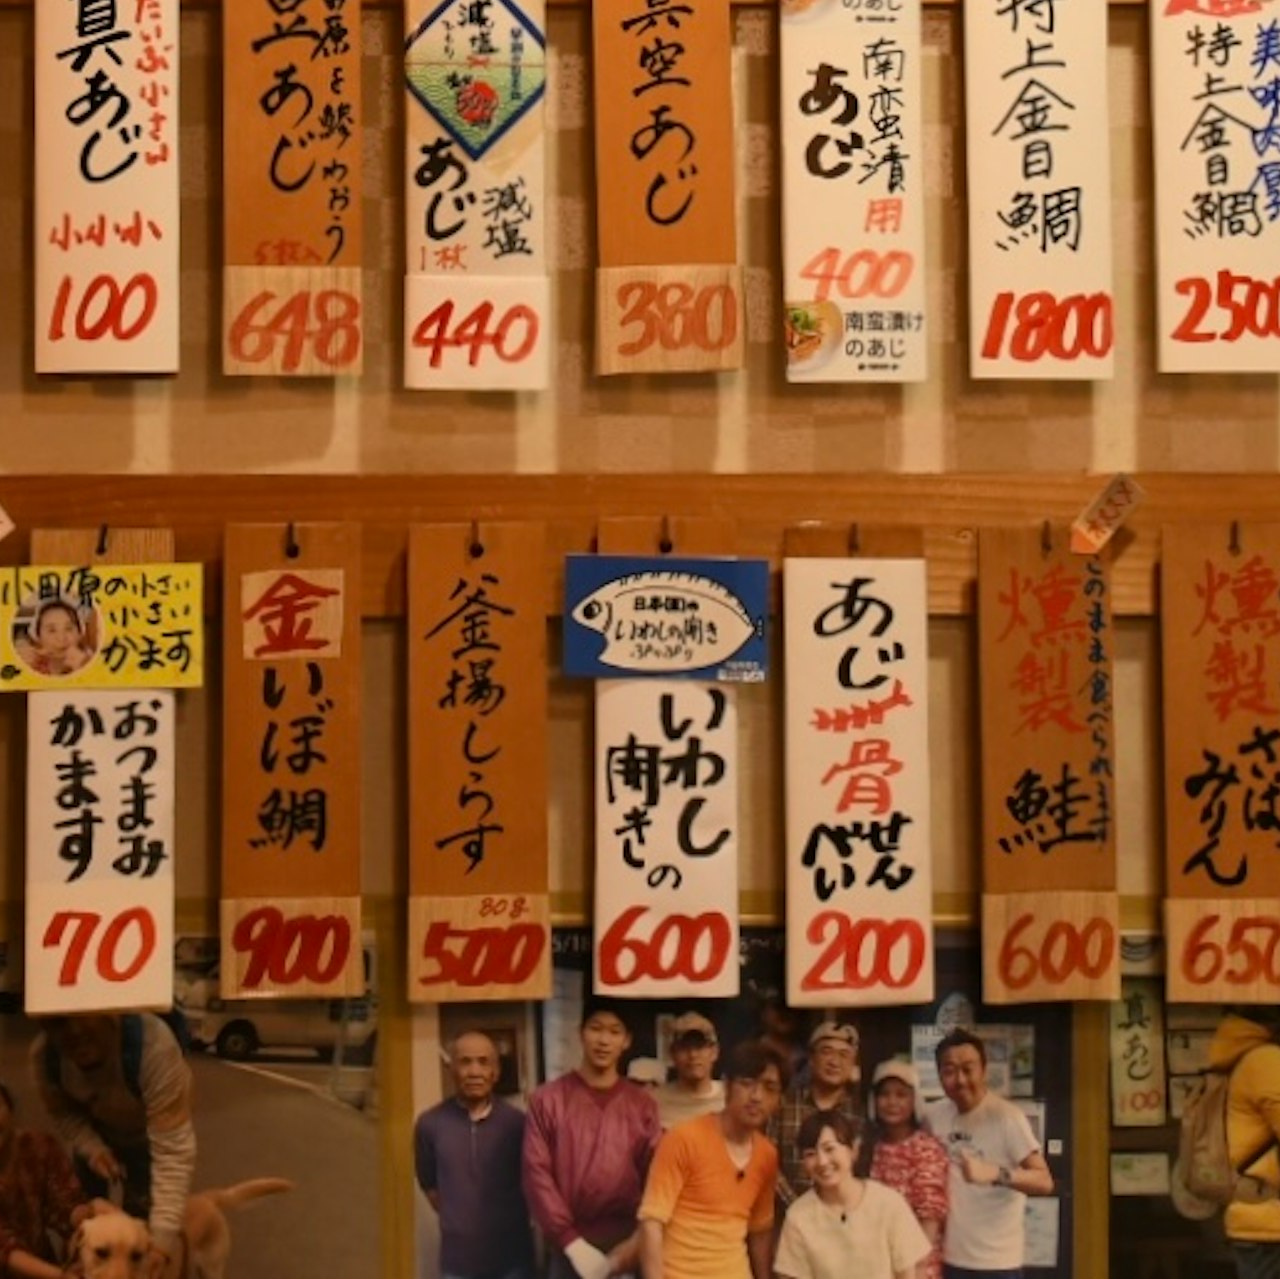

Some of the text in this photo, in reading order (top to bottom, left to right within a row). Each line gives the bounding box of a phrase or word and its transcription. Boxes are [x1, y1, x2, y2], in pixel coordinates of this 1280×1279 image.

[799, 63, 863, 179] あじ
[1180, 23, 1263, 237] 特上金目鯛
[413, 136, 477, 240] あじ
[48, 275, 158, 341] 100
[800, 248, 913, 303] 400
[229, 291, 360, 371] 648
[413, 300, 538, 367] 440
[618, 282, 736, 354] 380
[844, 339, 906, 358] のあじ
[981, 292, 1113, 362] 1800
[50, 703, 106, 883] かます
[112, 700, 166, 878] おつまみ
[247, 660, 335, 853] いぼ鯛
[996, 763, 1100, 855] 鮭
[42, 906, 158, 986] 70
[232, 907, 352, 989] 900
[420, 922, 546, 986] 500
[600, 907, 733, 985] 600
[800, 911, 927, 991] 200
[999, 914, 1115, 988] 600
